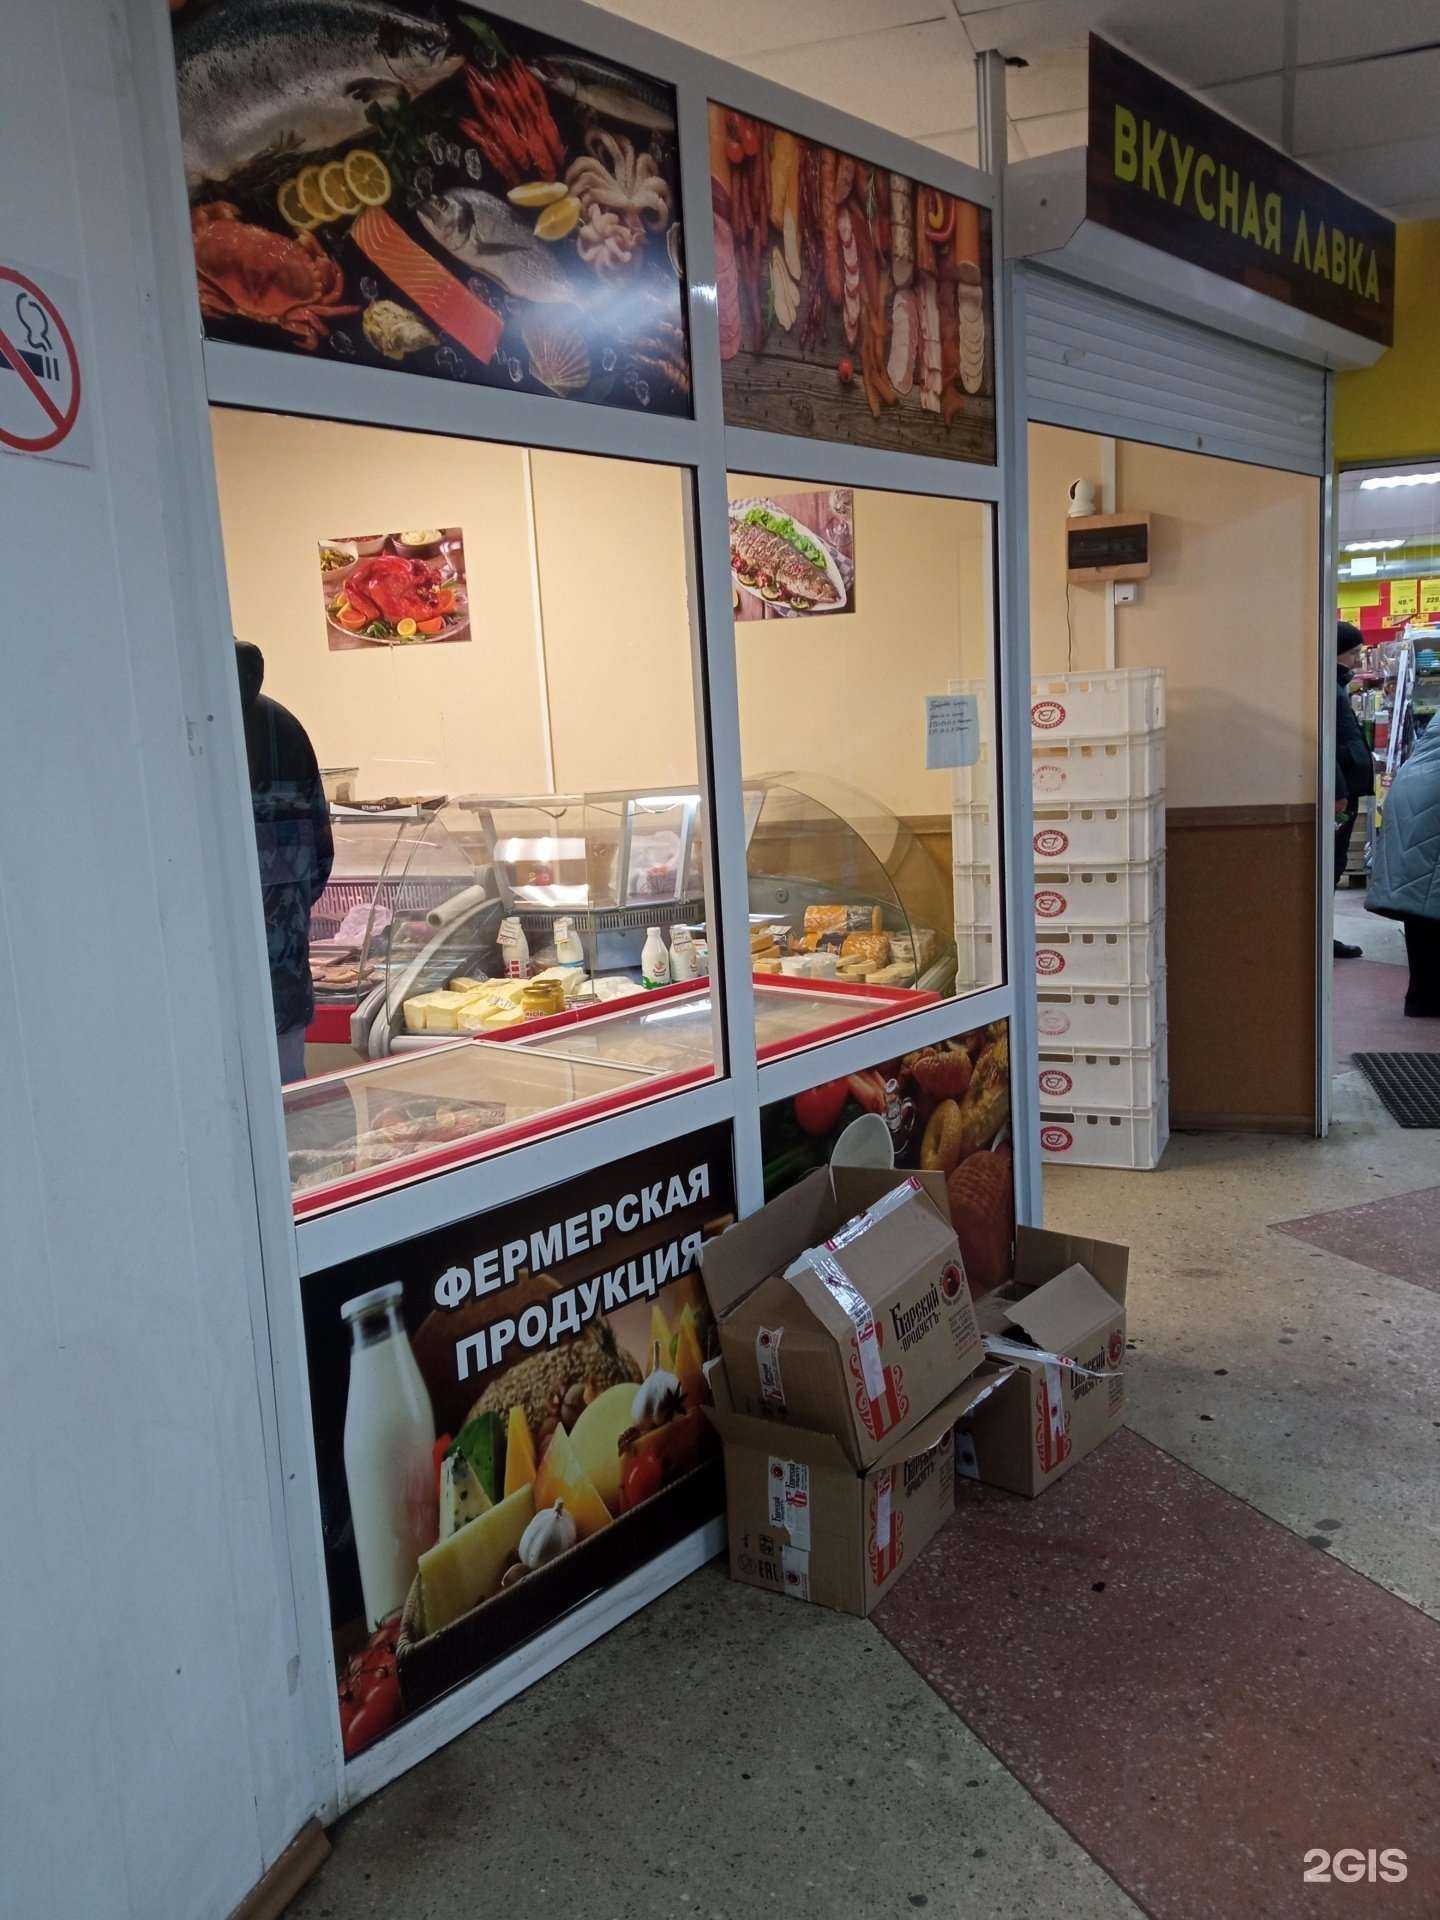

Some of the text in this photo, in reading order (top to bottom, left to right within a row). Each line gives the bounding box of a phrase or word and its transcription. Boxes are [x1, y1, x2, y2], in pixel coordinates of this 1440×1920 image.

[1114, 104, 1380, 303] ВКУСНАЯ ЛАВКА
[434, 1164, 710, 1308] ФЕРМЕРСКАЯ
[455, 1229, 705, 1382] ПРОДУКЦИЯ
[888, 1282, 940, 1341] Барский
